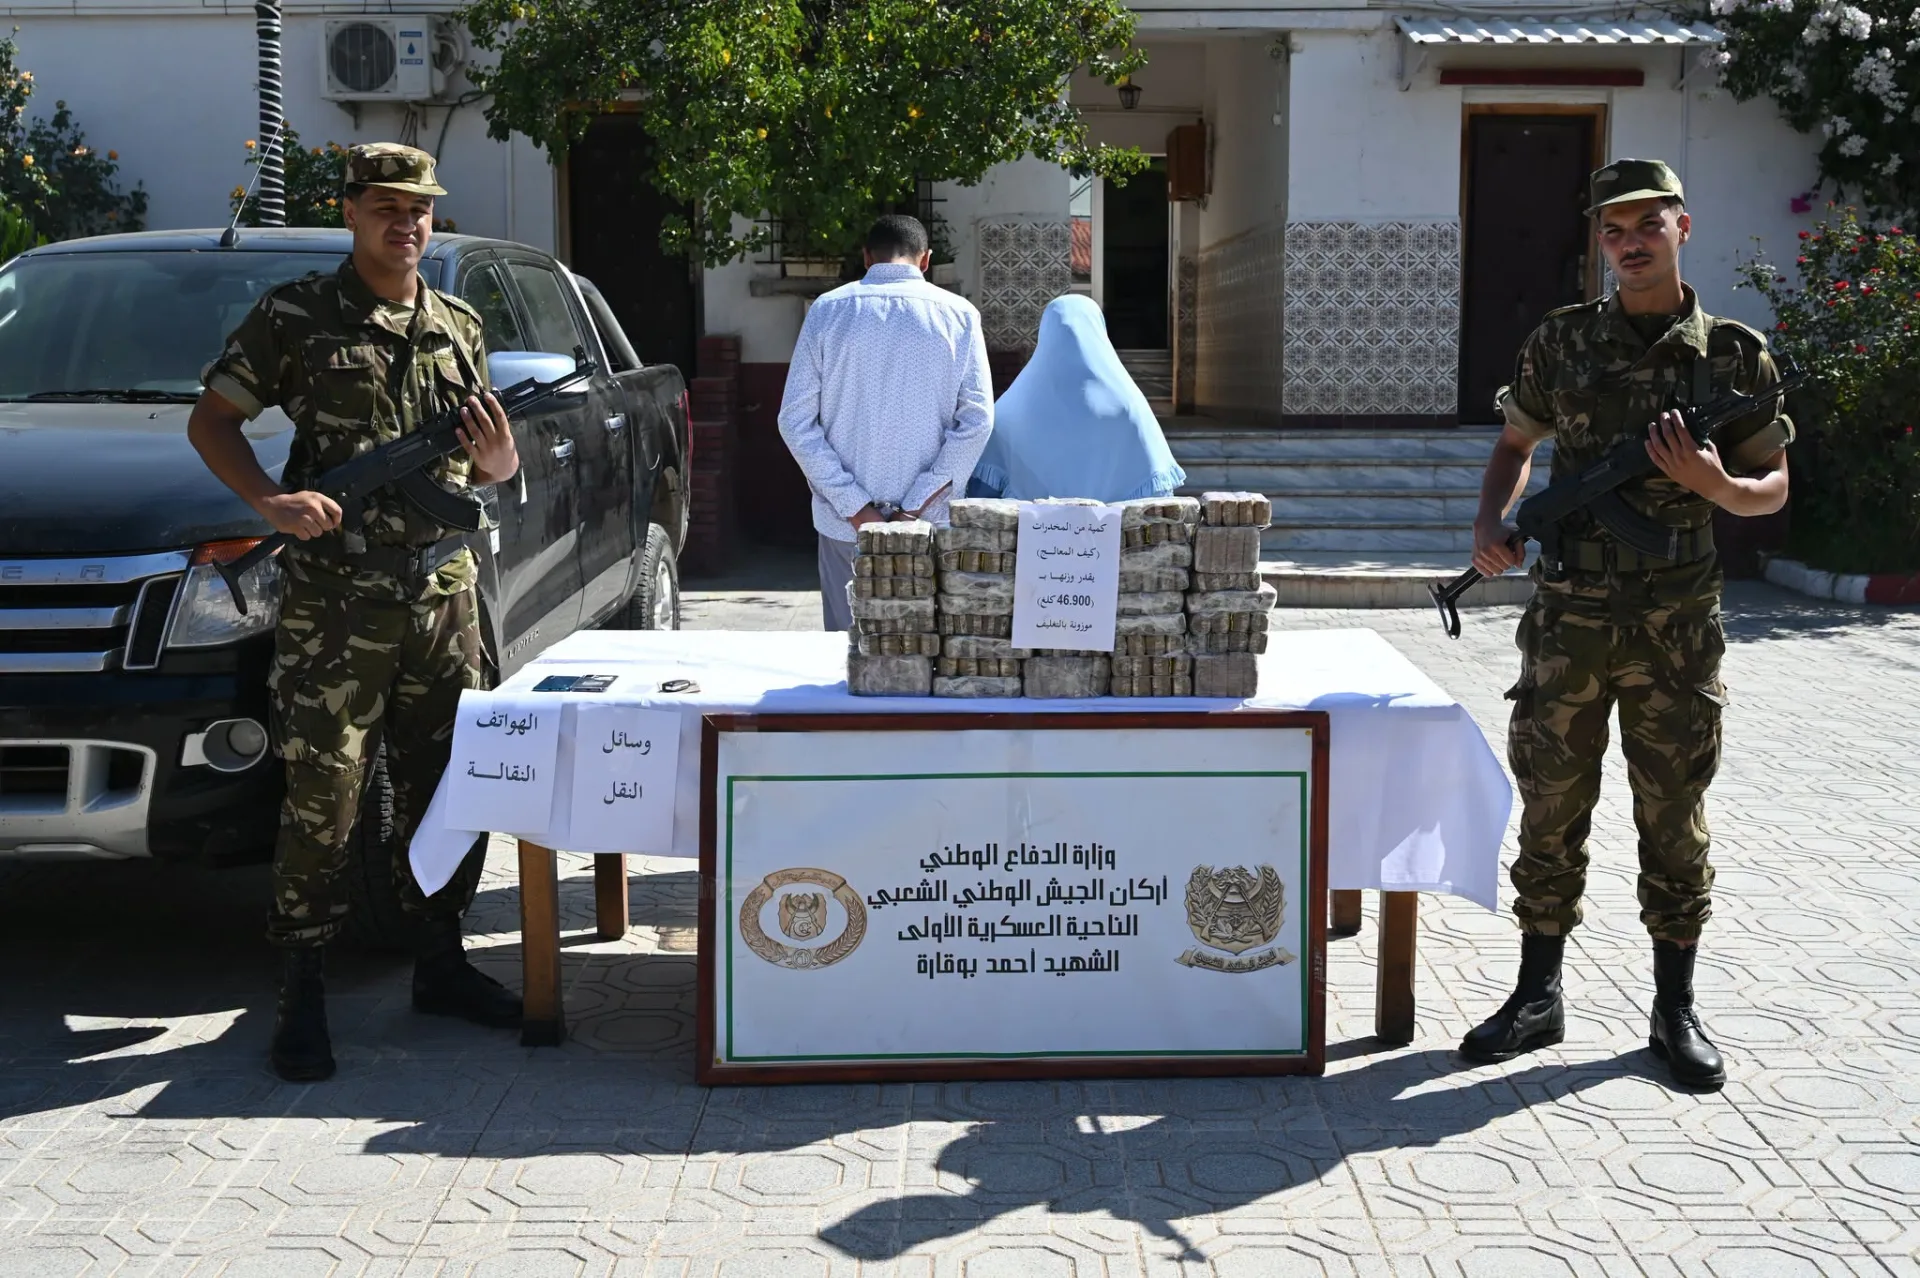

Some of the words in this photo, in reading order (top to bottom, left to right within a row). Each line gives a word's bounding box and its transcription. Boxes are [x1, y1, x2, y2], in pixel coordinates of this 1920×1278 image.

[1033, 522, 1071, 533] المخدرات
[1074, 527, 1085, 535] من
[1088, 524, 1107, 534] كمية
[1078, 573, 1095, 583] يقدر
[1070, 621, 1092, 631] موزونة
[477, 711, 537, 735] الهواتف
[603, 730, 651, 755] وسائل
[604, 781, 642, 804] النقل
[920, 843, 997, 873] الوطني
[1004, 843, 1067, 872] الدفاع
[1073, 843, 1115, 870] وزارة
[868, 879, 947, 909] الشعبي
[953, 879, 1030, 908] الوطني
[1037, 877, 1103, 906] الجيش
[898, 913, 962, 943] الأولى
[968, 914, 1061, 943] العسكرية
[1067, 914, 1138, 940] الناحية
[918, 952, 977, 979] بوقارة
[986, 948, 1035, 973] أحمد
[1044, 949, 1119, 976] الشهيد
